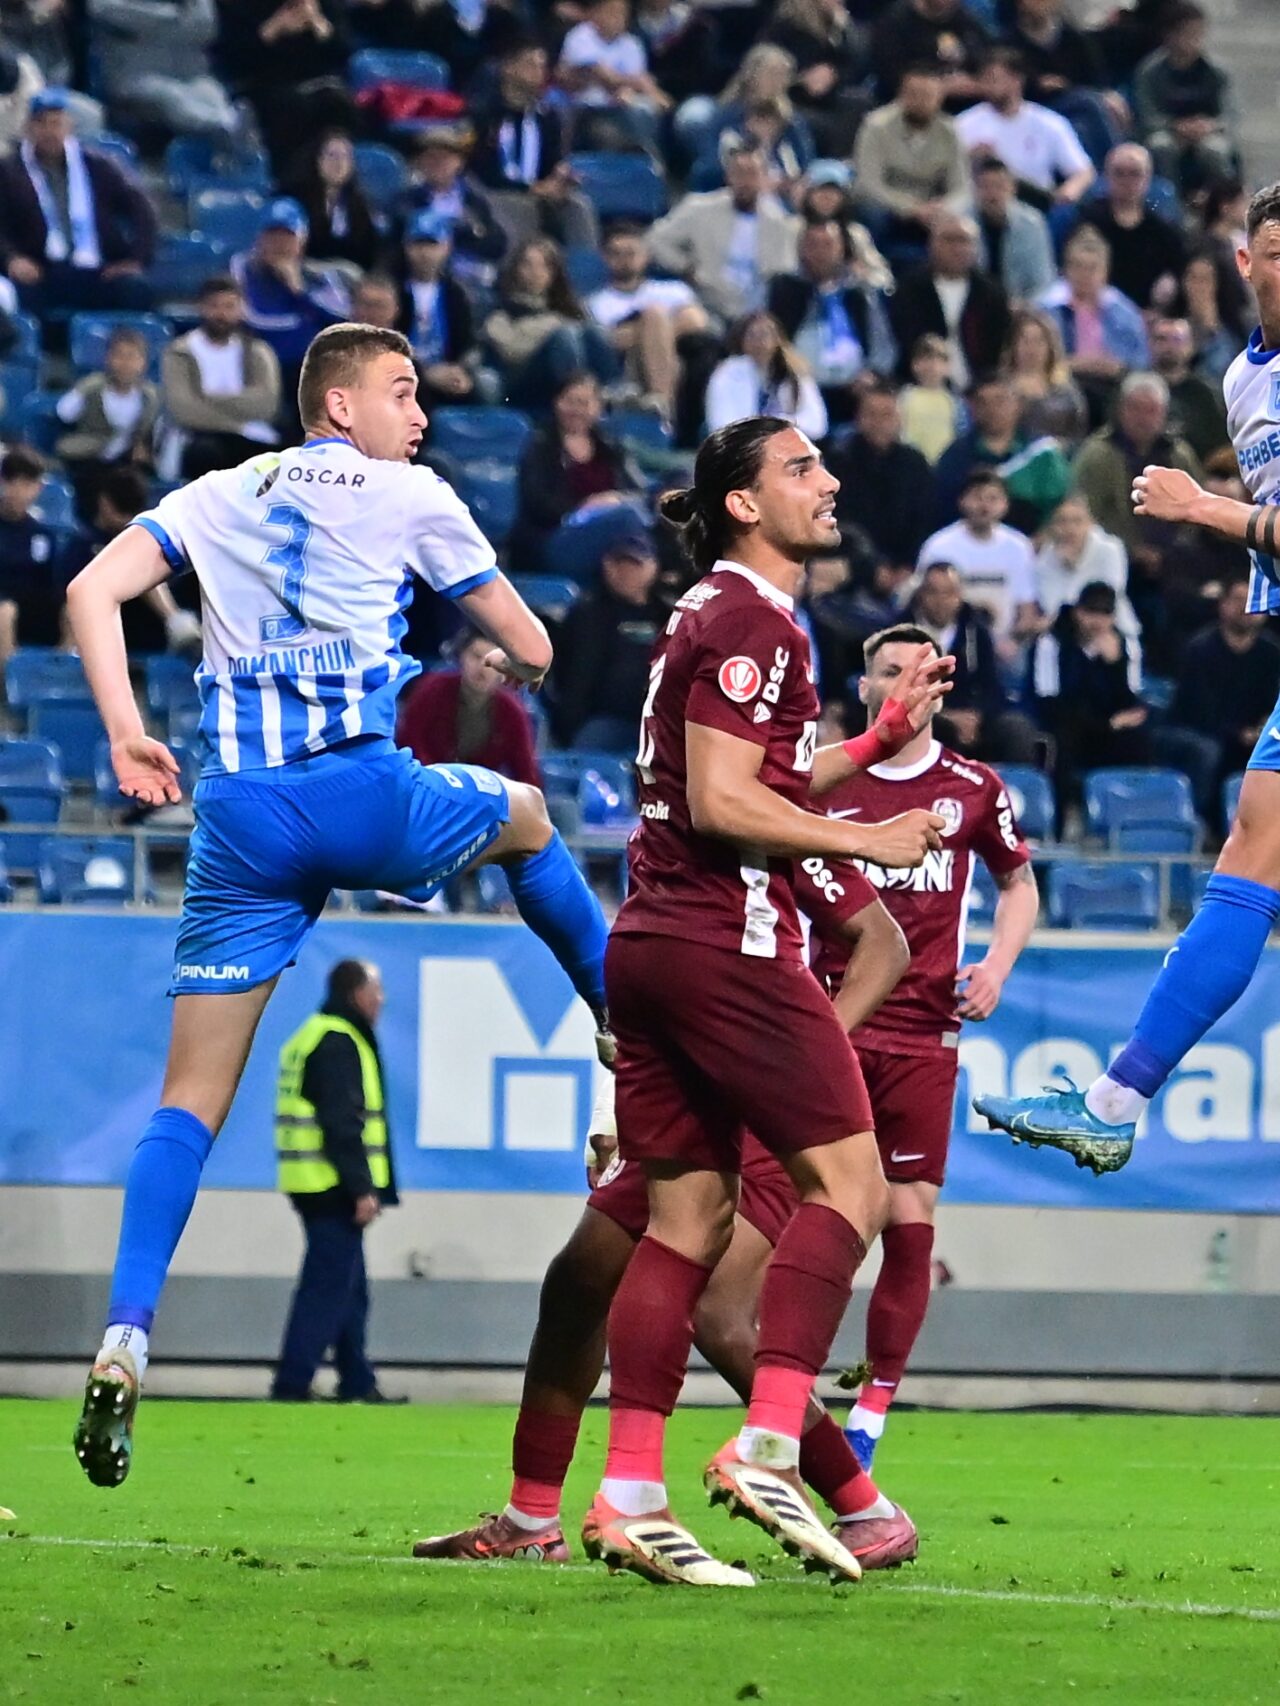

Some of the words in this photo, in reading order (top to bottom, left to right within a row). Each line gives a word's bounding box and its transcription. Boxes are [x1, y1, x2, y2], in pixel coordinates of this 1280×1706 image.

[287, 466, 366, 488] OSCAR
[260, 501, 313, 645] 3
[227, 639, 356, 675] DOMANCHUK
[762, 646, 790, 704] DSC
[998, 809, 1018, 852] DSC
[801, 857, 846, 904] DSC
[180, 964, 250, 980] PINUM
